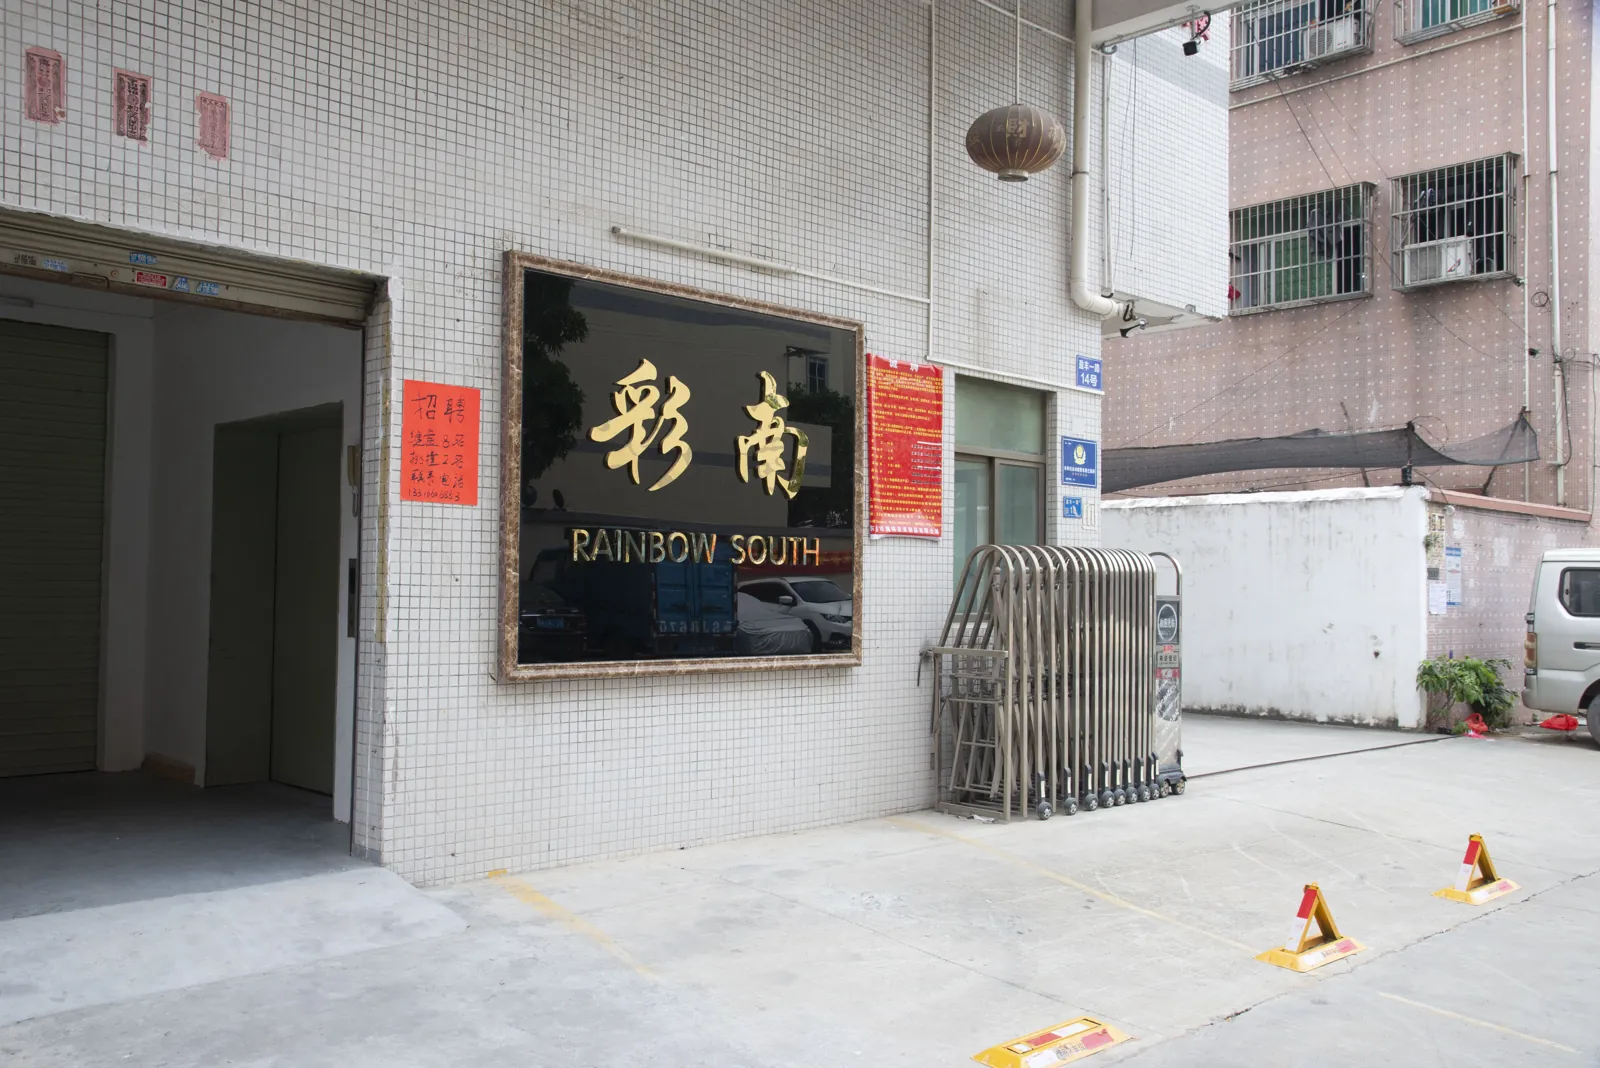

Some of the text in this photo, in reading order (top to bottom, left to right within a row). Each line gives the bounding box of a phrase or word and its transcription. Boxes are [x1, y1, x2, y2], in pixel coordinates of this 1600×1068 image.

[1080, 372, 1098, 387] 14号
[411, 393, 466, 424] 招聘
[587, 358, 810, 499] 彩南
[571, 528, 820, 566] RAINBOW SOUTH
